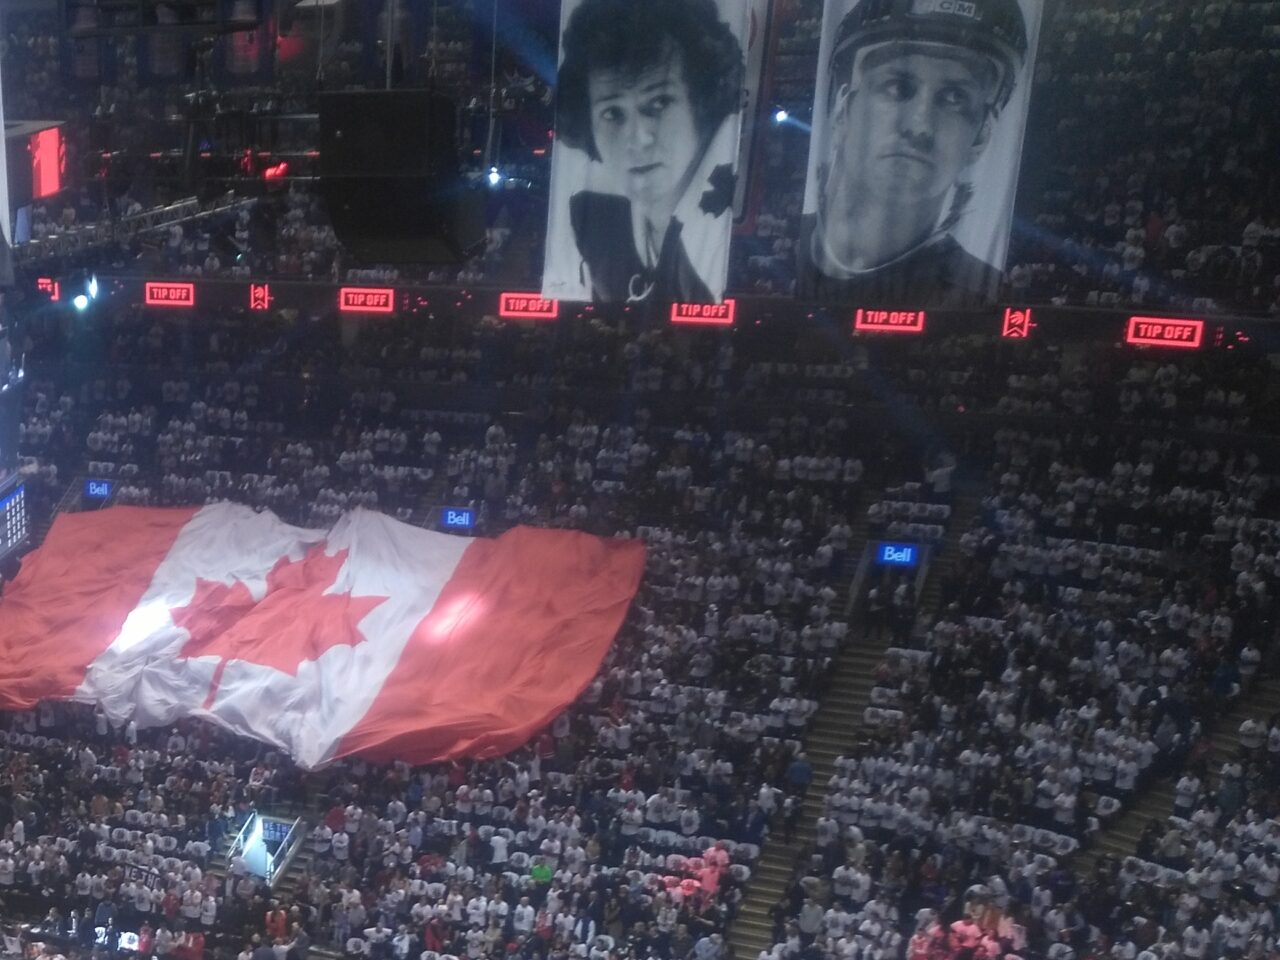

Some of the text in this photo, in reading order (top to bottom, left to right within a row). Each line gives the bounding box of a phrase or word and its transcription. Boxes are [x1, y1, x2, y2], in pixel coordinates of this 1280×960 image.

[152, 288, 188, 300] TIP OFF
[348, 293, 386, 306] TIP OFF
[508, 299, 551, 311] TIP OFF
[680, 304, 726, 317] TIP OFF
[866, 311, 914, 325] TIP OFF
[1138, 323, 1192, 339] TIP OFF
[89, 482, 107, 495] Bell
[447, 511, 469, 525] Bell
[883, 546, 911, 562] Bell
